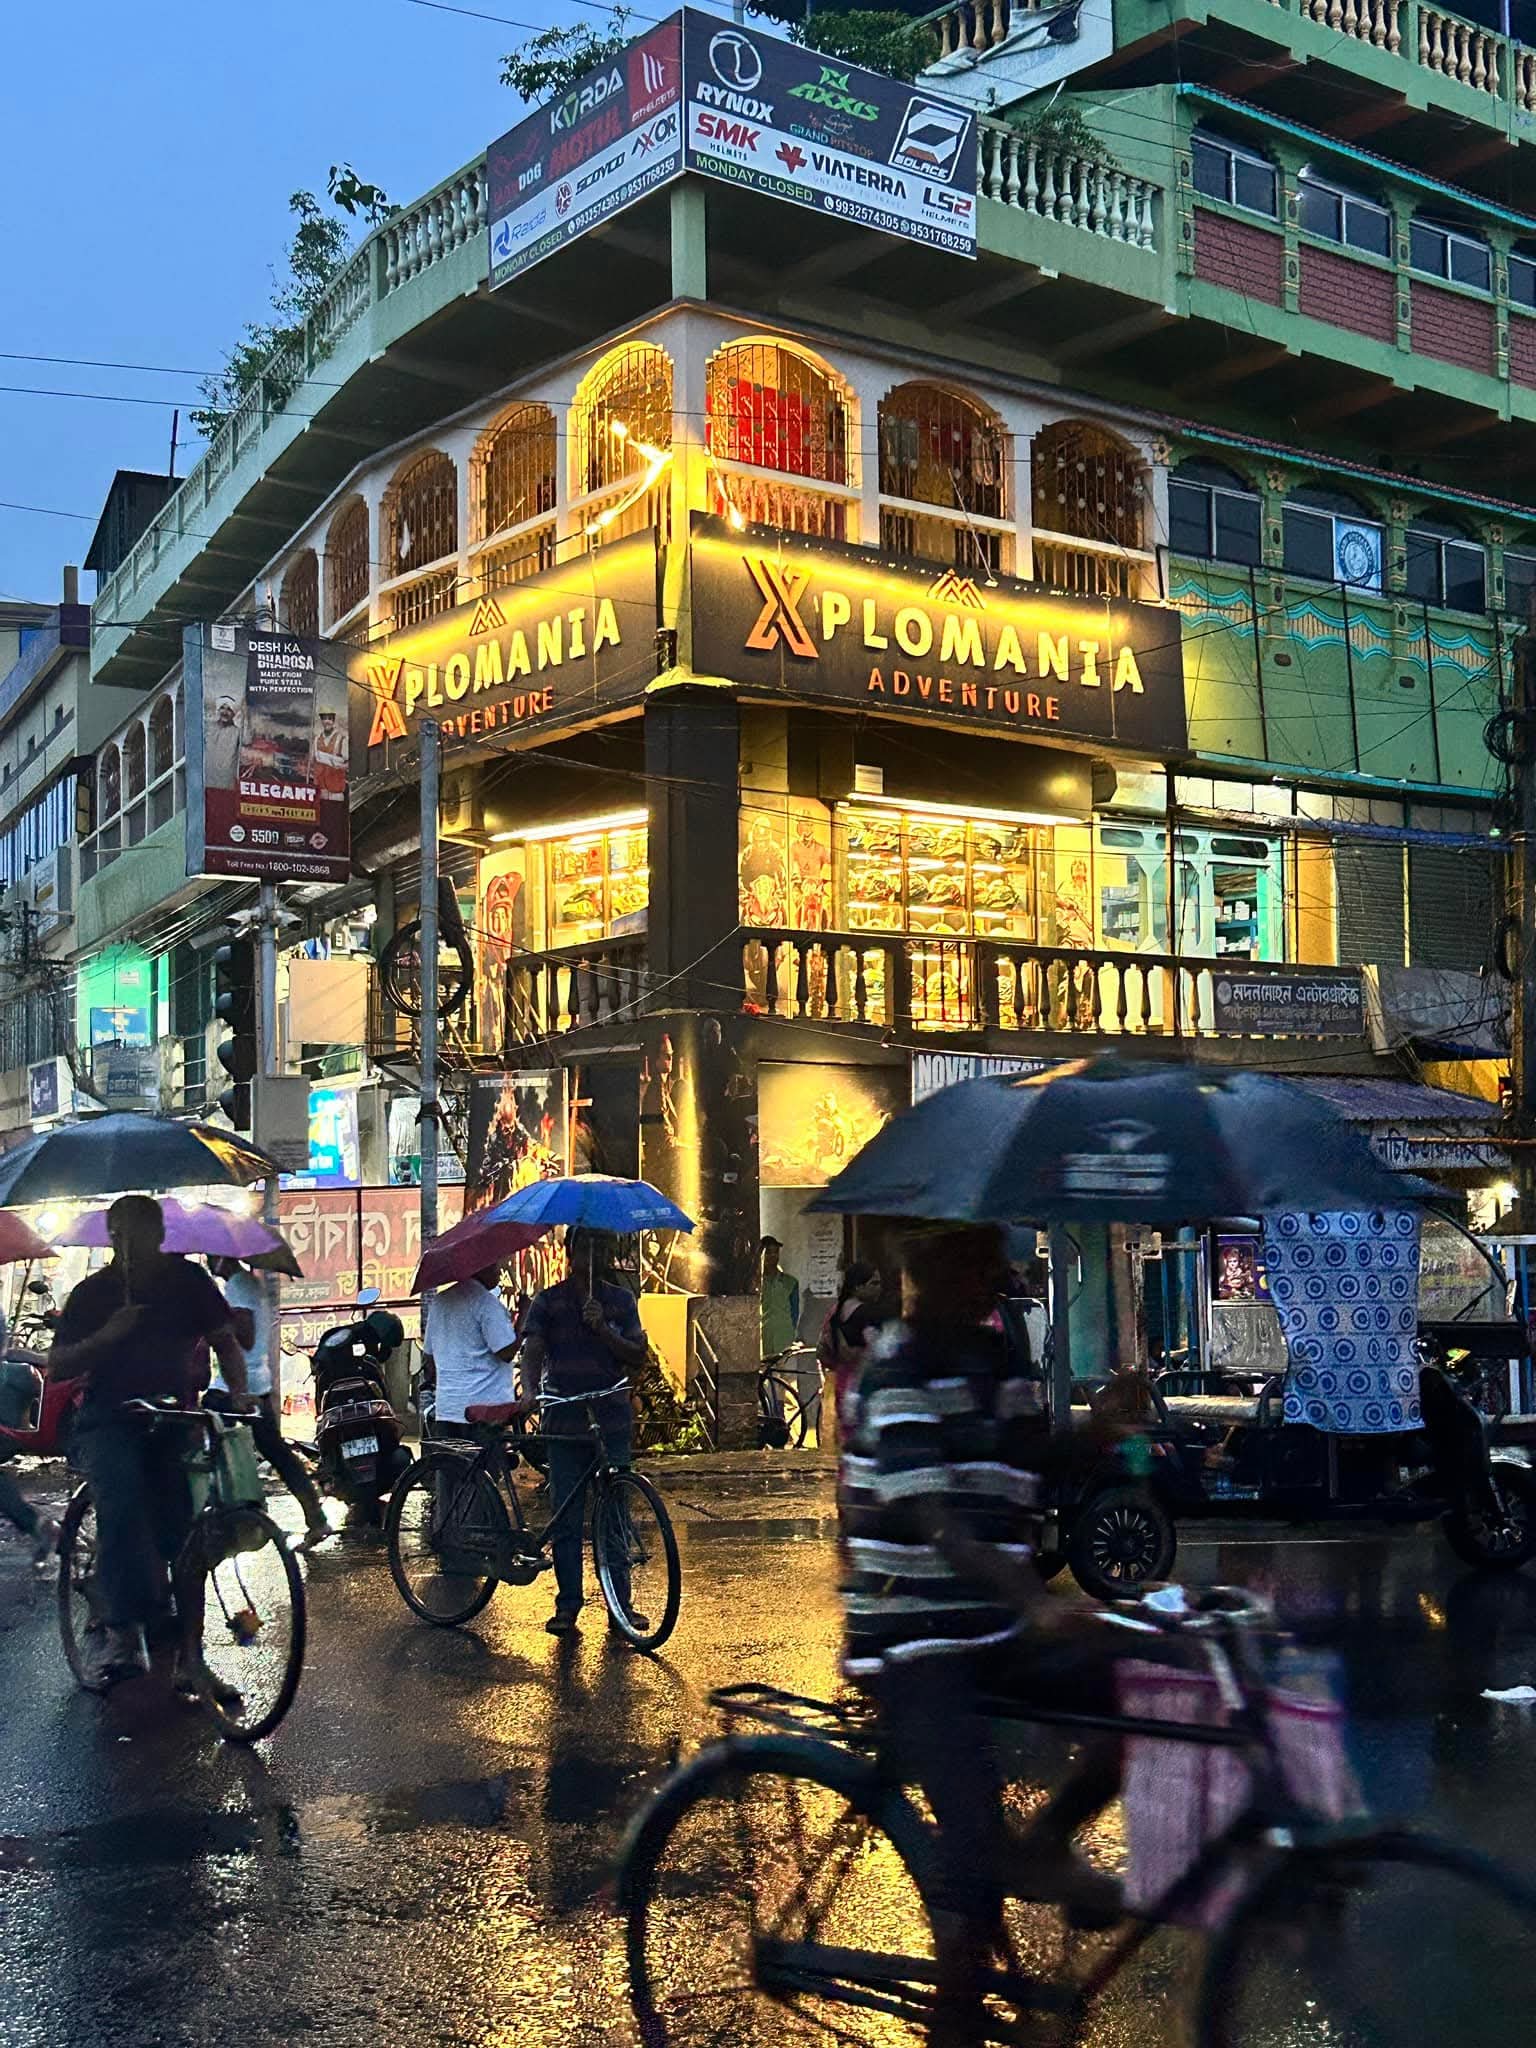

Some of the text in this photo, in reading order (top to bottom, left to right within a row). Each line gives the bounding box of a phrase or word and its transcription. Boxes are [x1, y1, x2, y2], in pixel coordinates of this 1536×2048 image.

[697, 81, 775, 123] RYNOX
[631, 112, 678, 158] AXOR
[695, 112, 761, 152] SMK
[710, 142, 748, 161] HELMETS
[789, 123, 829, 144] GRAND
[811, 151, 908, 199] VIATERRA
[893, 153, 949, 180] SOLACE
[696, 154, 755, 184] MONDAY
[835, 199, 900, 231] 9932574305
[910, 222, 973, 253] 9531768259
[923, 186, 972, 219] LS2
[746, 555, 1145, 694] XPLOMANIA
[249, 640, 301, 654] DESH KA
[366, 597, 622, 748] XPLOMANIA
[441, 686, 554, 738] DVENTURE
[867, 667, 1061, 722] ADVENTURE
[240, 781, 317, 802] ELEGANT
